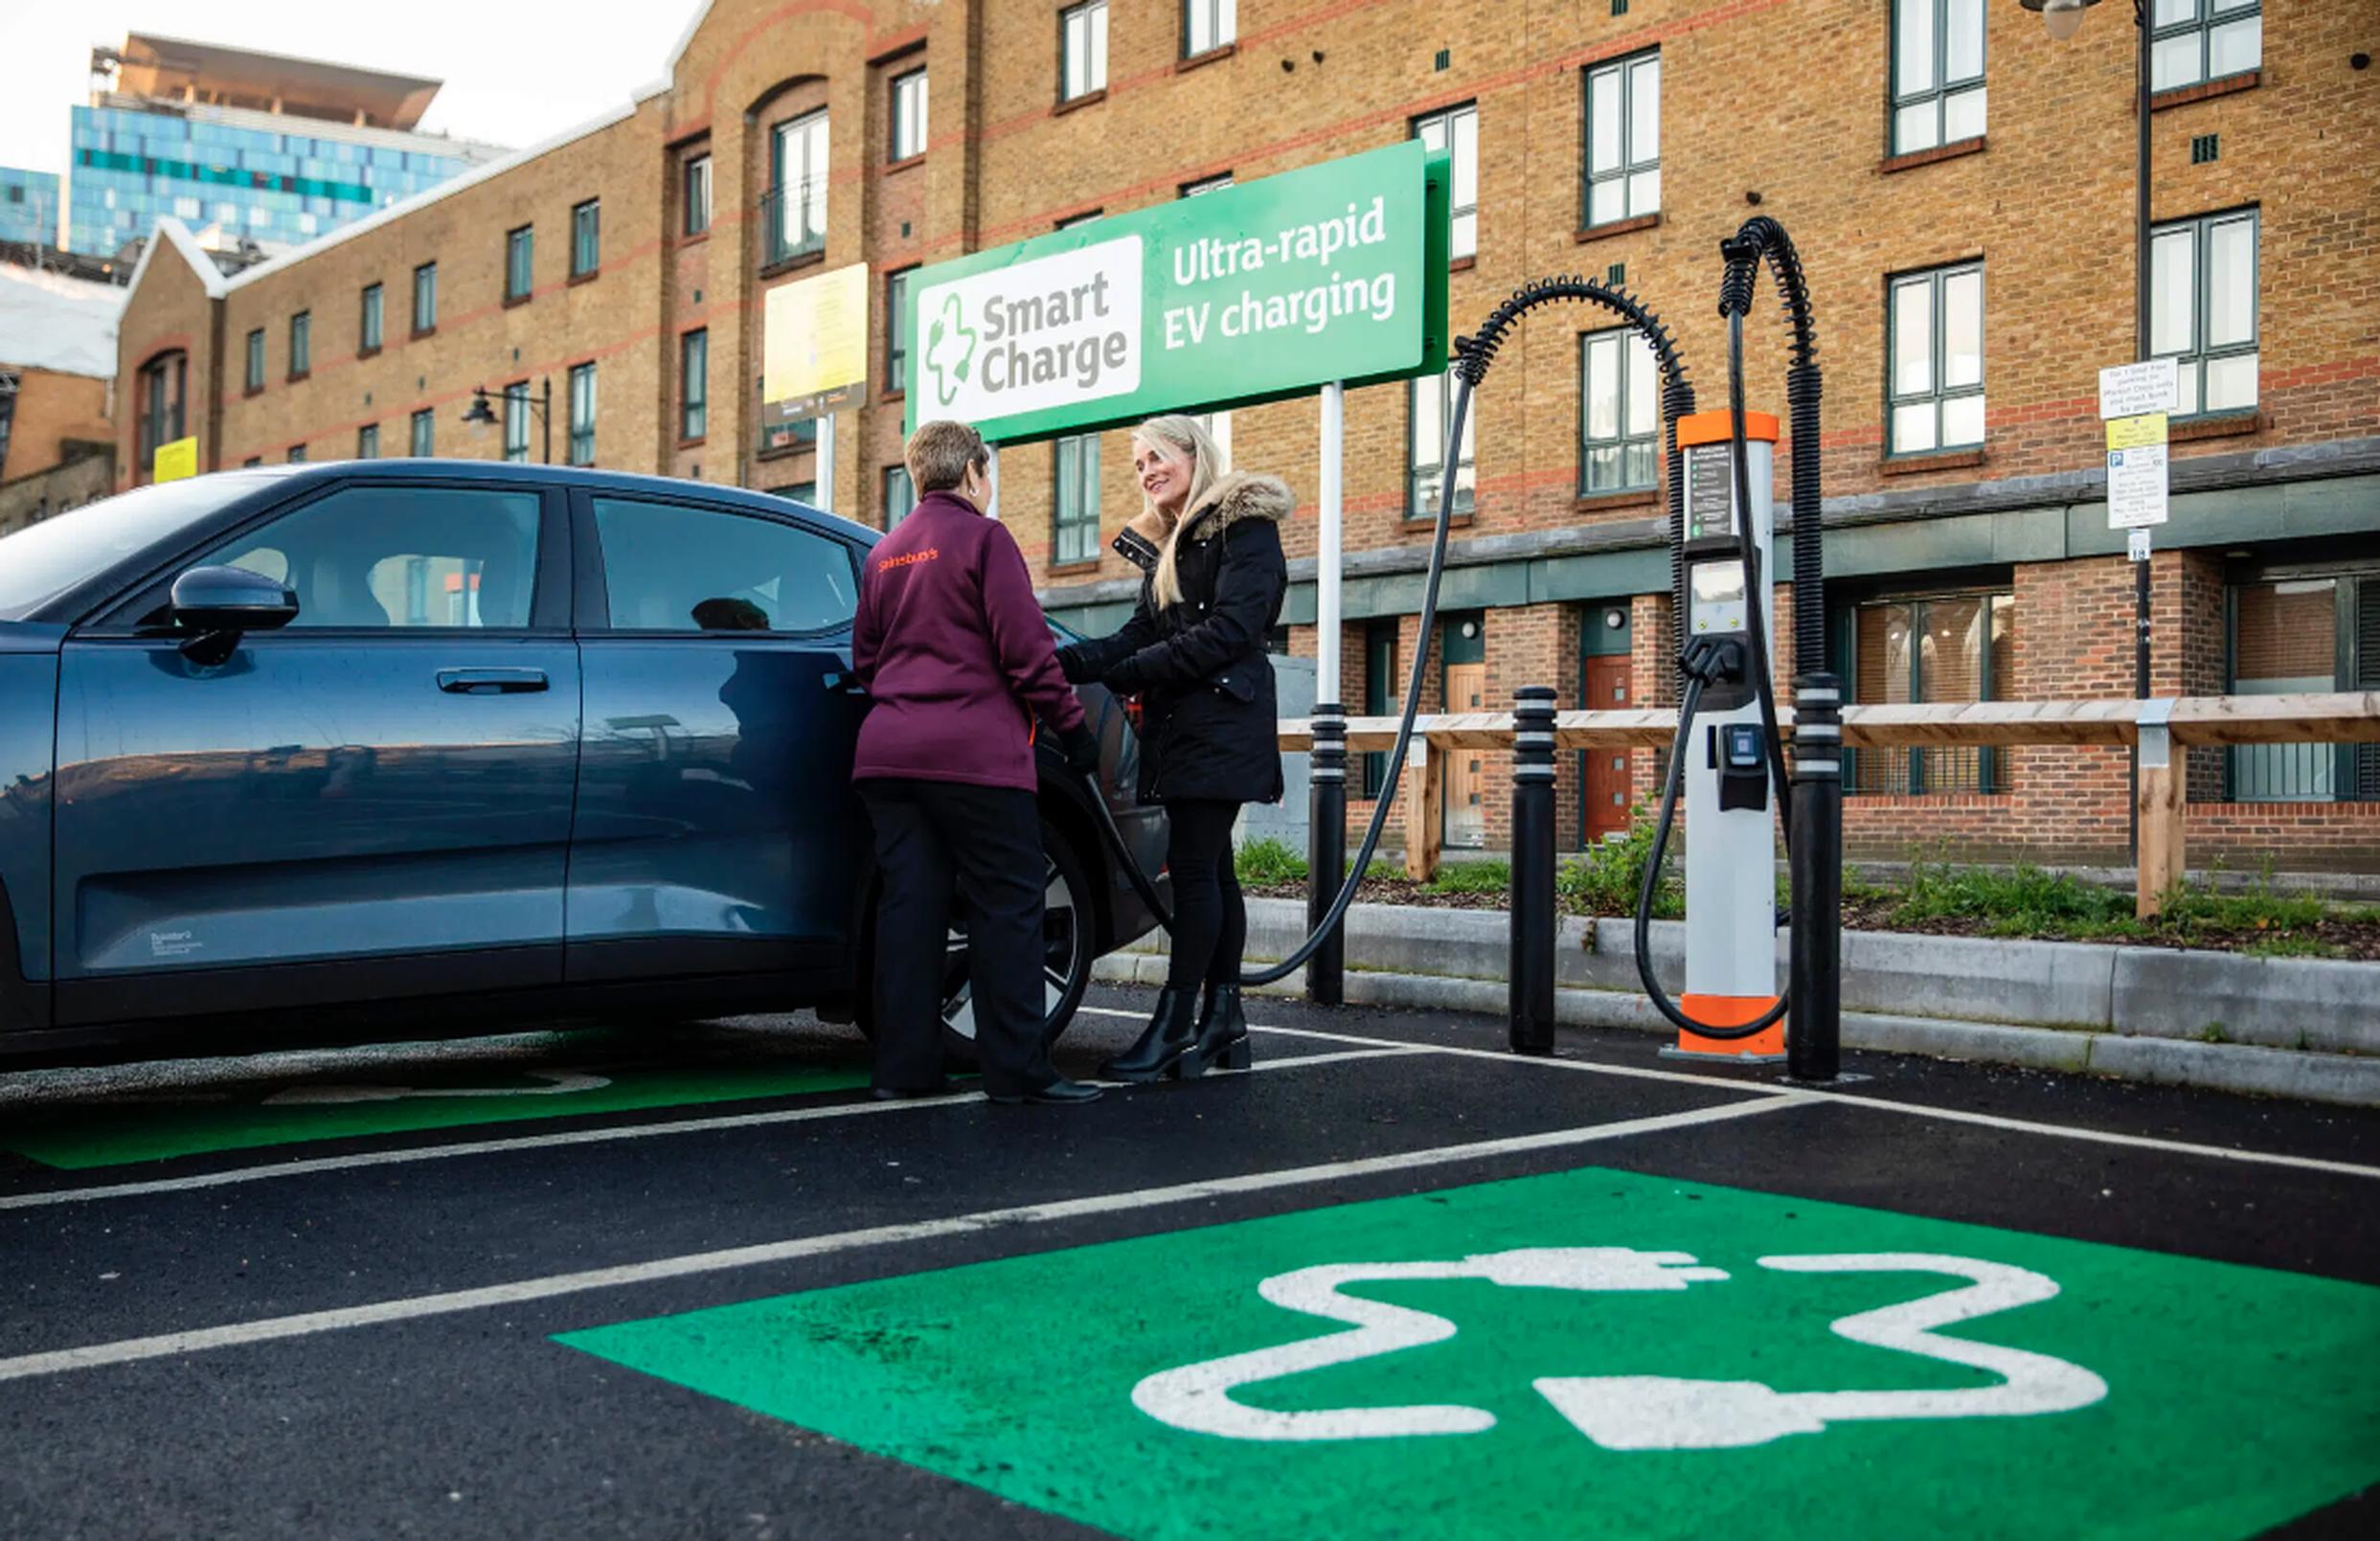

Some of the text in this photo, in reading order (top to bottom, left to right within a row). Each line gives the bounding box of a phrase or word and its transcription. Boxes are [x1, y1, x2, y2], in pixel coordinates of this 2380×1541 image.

[1173, 194, 1386, 286] Ultra-rapid
[984, 270, 1109, 342] Smart
[1164, 271, 1395, 351] EV charging
[981, 330, 1127, 394] Charge
